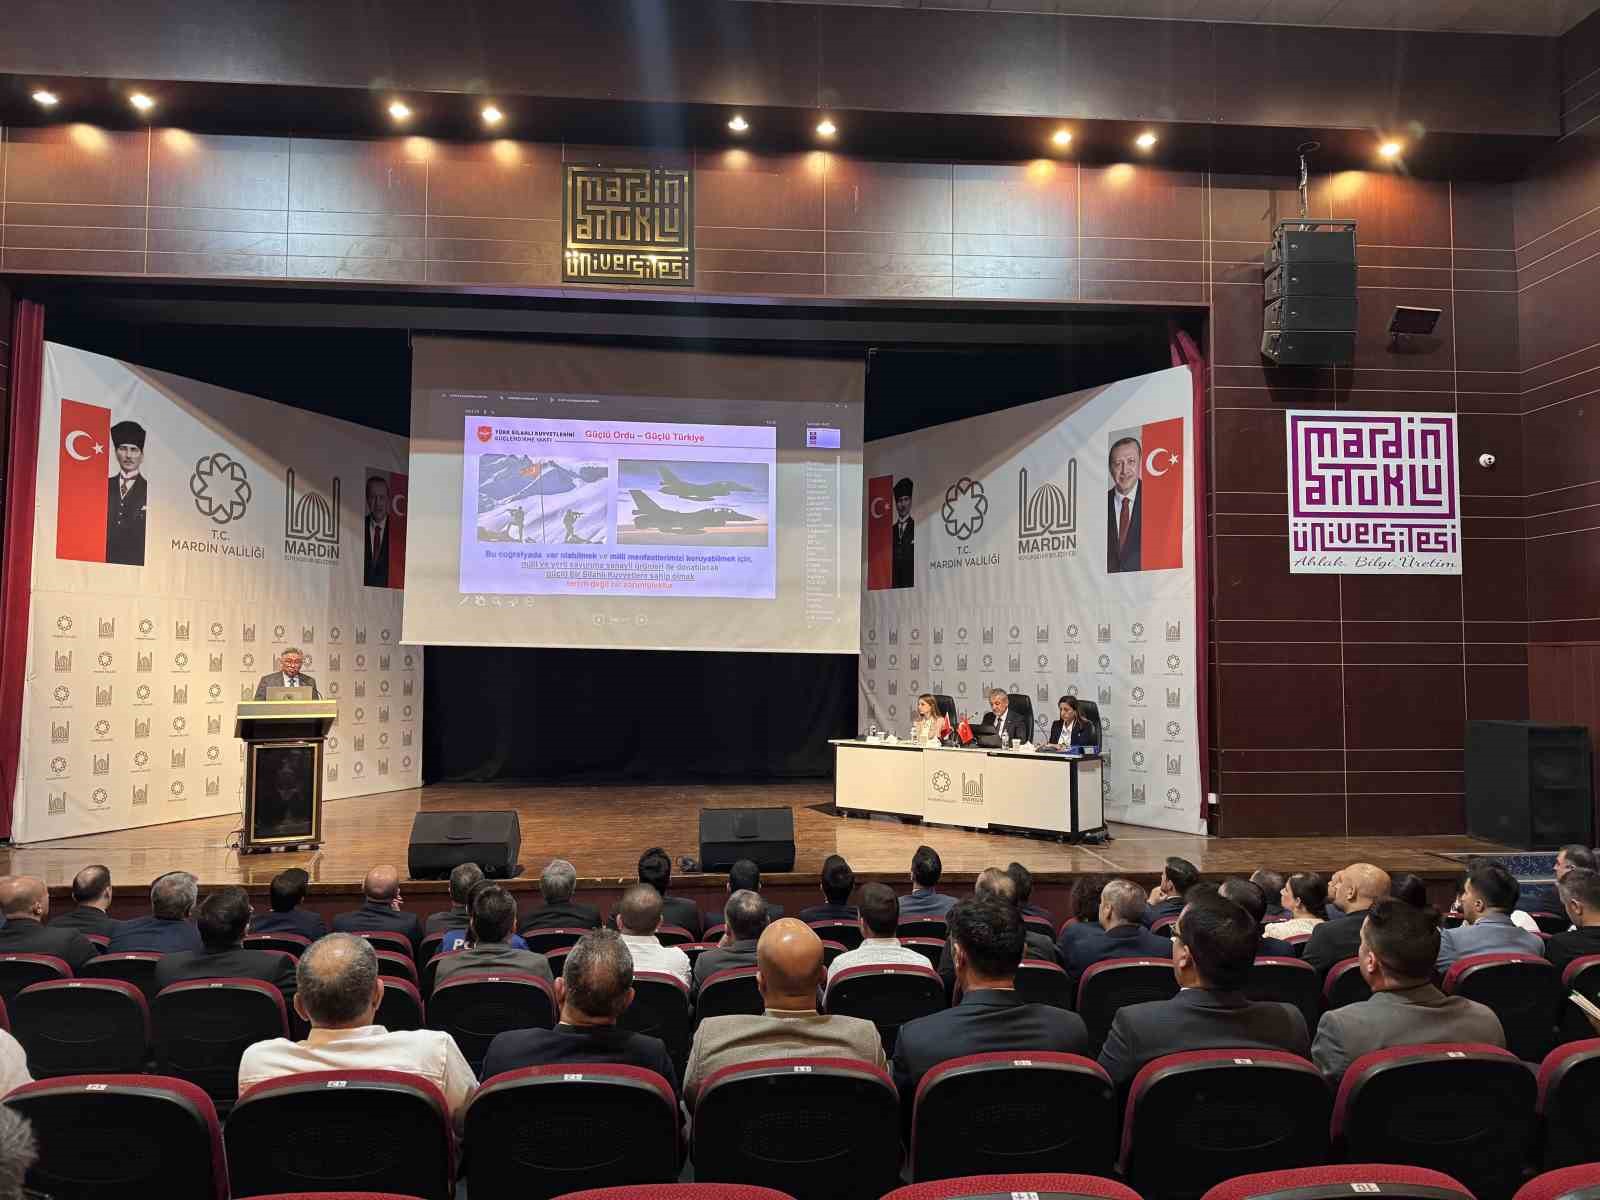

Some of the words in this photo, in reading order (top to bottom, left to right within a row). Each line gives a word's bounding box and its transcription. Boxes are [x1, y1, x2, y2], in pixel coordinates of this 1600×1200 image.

[584, 430, 611, 441] Güçlü
[613, 431, 635, 440] Ordu
[644, 432, 671, 442] Güçlü
[673, 433, 705, 443] Türkiye
[211, 529, 230, 541] T.C.
[171, 539, 218, 554] MARDİN
[220, 543, 265, 560] VALİLİĞİ
[284, 540, 340, 559] MARDİN
[957, 546, 971, 555] T.C.
[1017, 534, 1077, 554] MARDİN
[929, 558, 962, 570] MARDİN
[965, 553, 1001, 567] VALİLİĞİ
